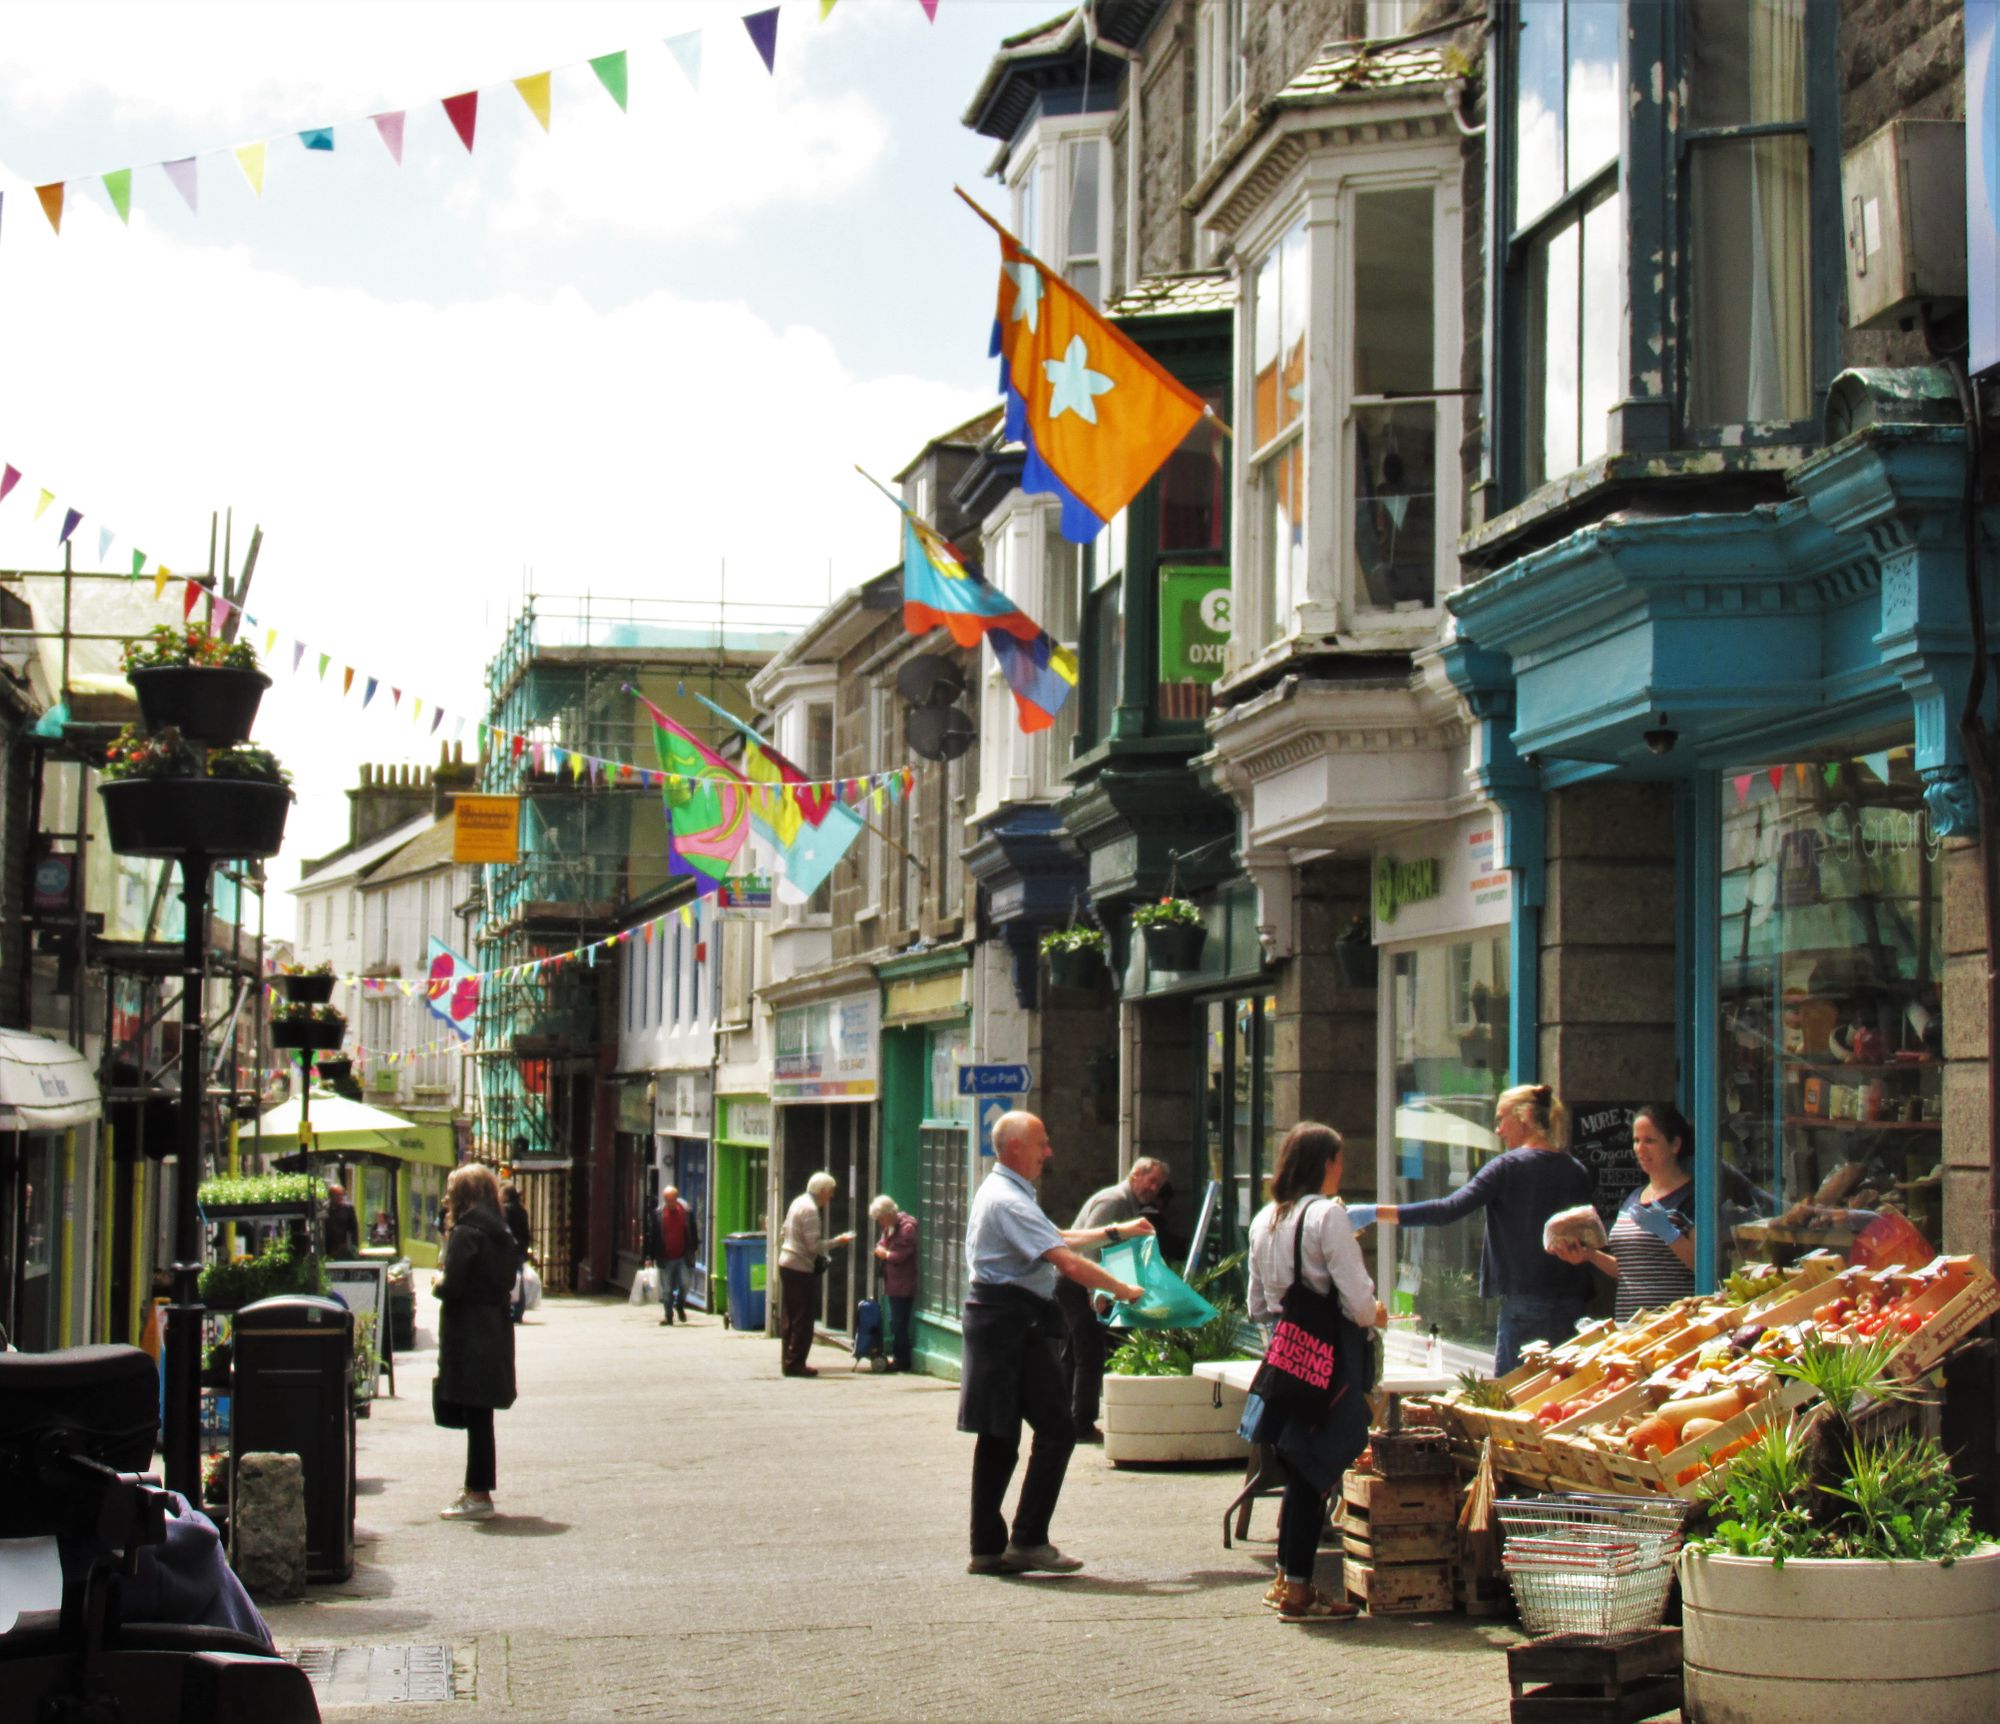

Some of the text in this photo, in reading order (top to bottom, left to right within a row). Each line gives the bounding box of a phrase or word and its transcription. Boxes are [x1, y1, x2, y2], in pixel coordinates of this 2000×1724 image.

[1189, 643, 1225, 664] OXF
[1830, 801, 1940, 864] Granary
[1396, 857, 1434, 905] OXFAM
[980, 1071, 1019, 1085] Car Park
[1580, 1108, 1621, 1136] MORE
[1590, 1148, 1637, 1168] Organ
[1938, 1301, 1981, 1338] Supreme
[1979, 1287, 1997, 1303] Bio
[1270, 1335, 1335, 1377] OUSING
